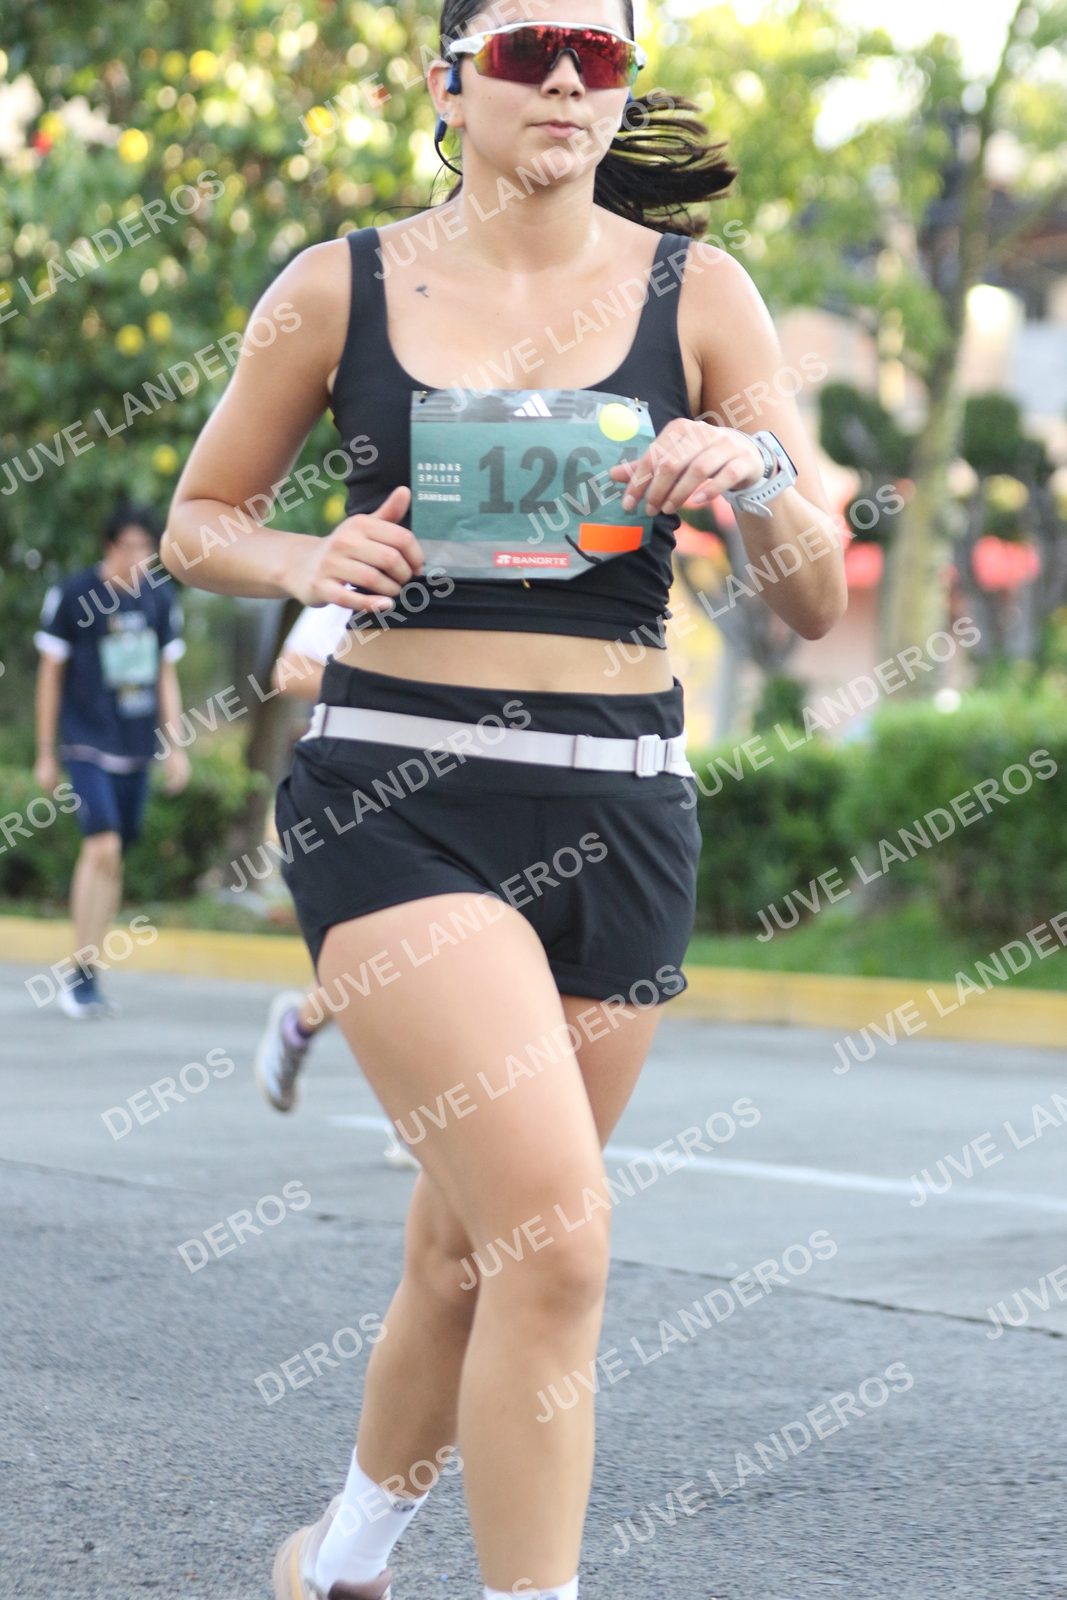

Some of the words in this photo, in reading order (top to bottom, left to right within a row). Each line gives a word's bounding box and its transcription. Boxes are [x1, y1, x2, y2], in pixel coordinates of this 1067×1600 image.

[417, 463, 461, 471] ADIDAS
[418, 474, 461, 483] SPLITS
[512, 556, 568, 565] BANORTE
